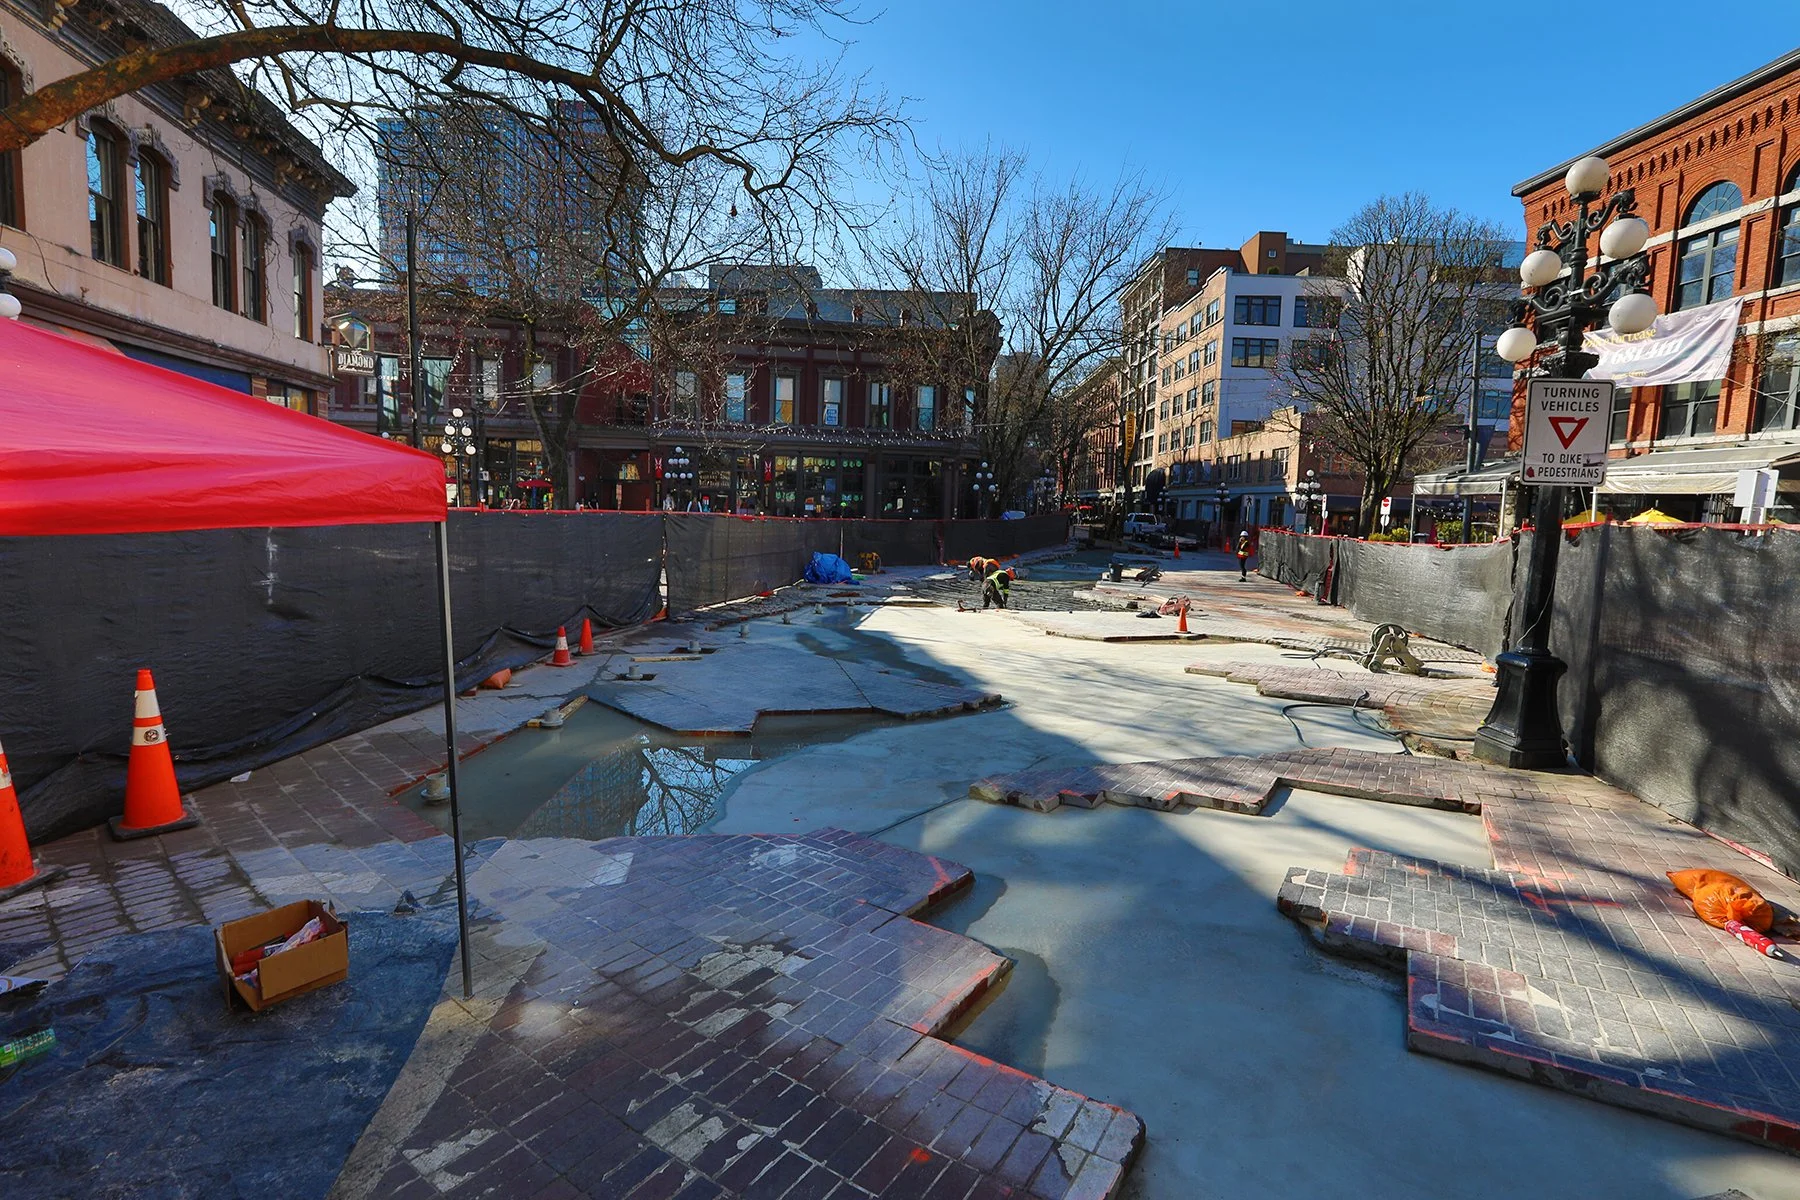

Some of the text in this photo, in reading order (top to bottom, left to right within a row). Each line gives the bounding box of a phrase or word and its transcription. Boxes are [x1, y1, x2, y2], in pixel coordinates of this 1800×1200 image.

[1628, 328, 1656, 342] Lease
[338, 353, 374, 369] DIAMOND
[1543, 387, 1600, 399] TURNING
[1541, 401, 1599, 412] VEHICLES
[1542, 453, 1582, 464] TO BIKE
[1537, 467, 1599, 478] PEDESTRIANS
